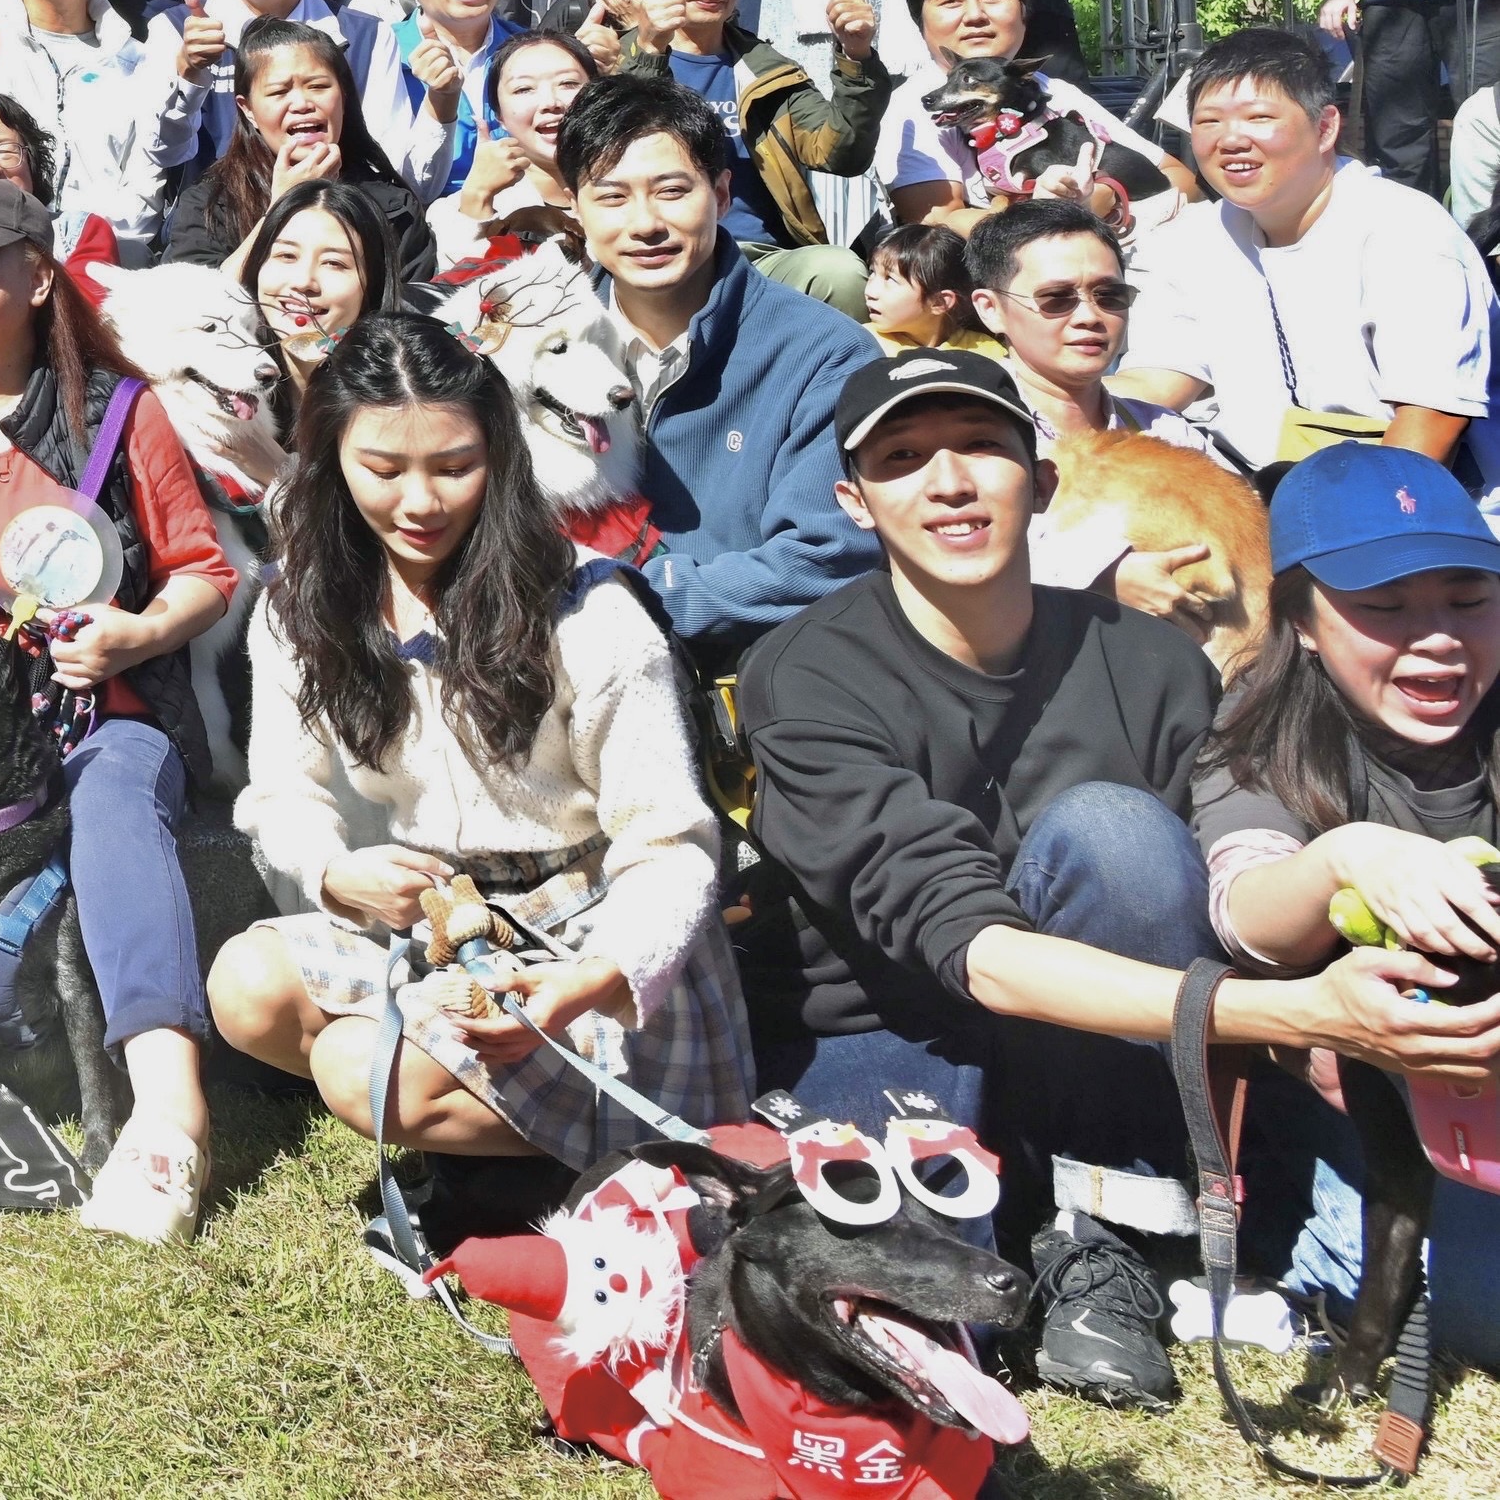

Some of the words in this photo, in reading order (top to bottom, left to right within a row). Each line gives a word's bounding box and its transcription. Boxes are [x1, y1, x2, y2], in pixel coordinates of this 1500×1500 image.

[706, 100, 737, 114] YO
[727, 429, 743, 452] C
[787, 1429, 906, 1483] 黑金
